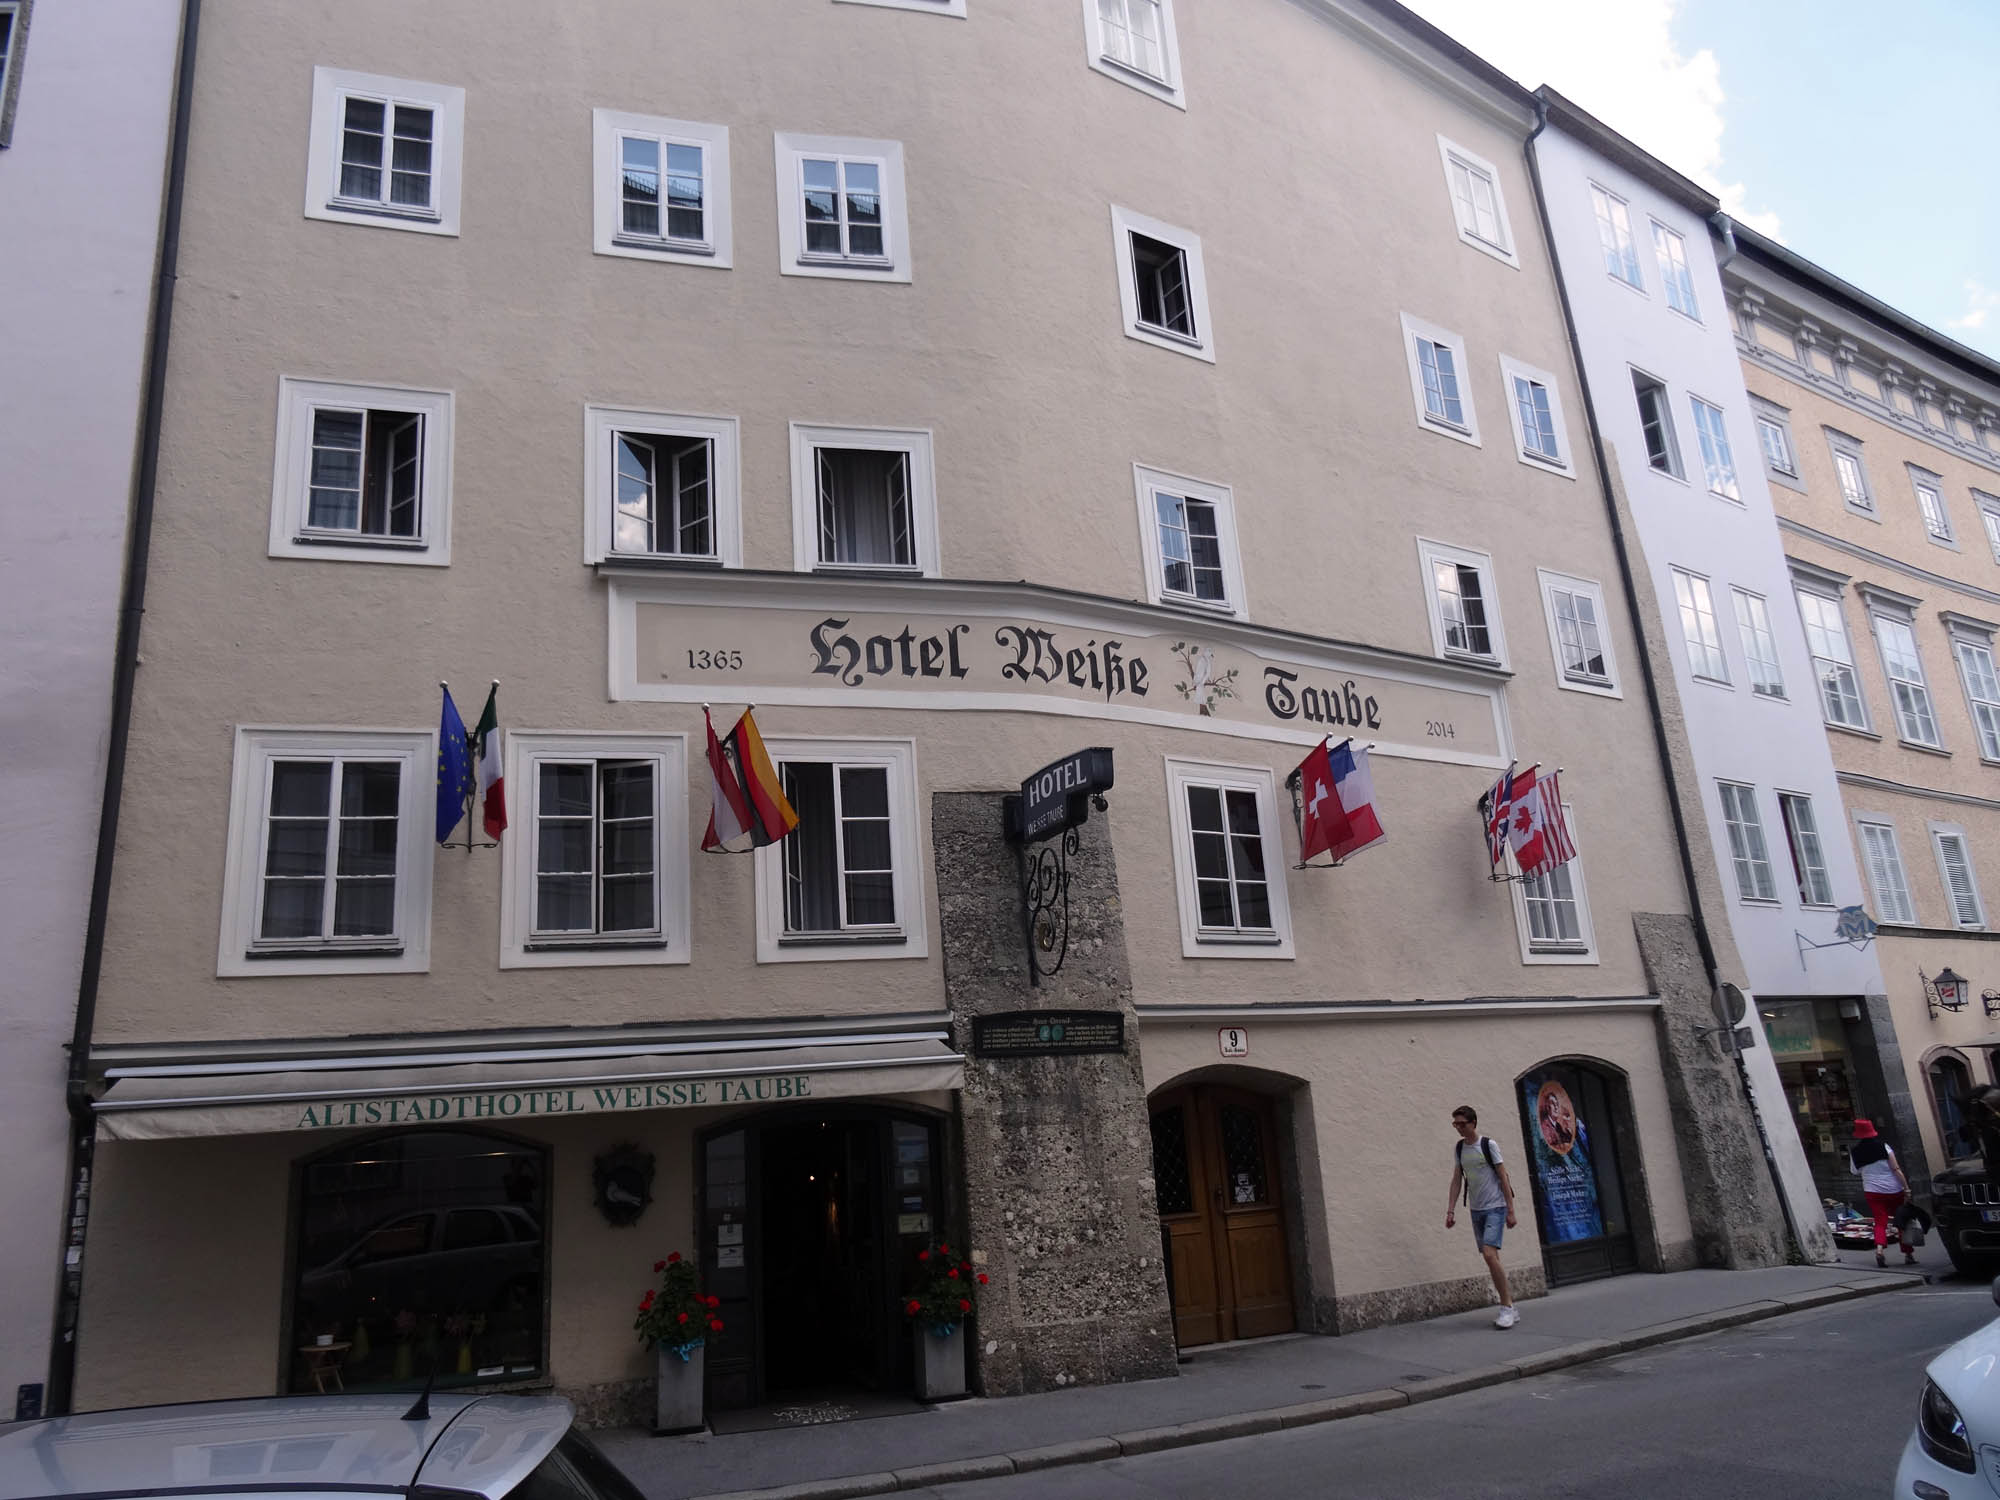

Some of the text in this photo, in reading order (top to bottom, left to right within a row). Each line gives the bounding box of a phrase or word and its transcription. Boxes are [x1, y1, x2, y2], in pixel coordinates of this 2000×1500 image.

[687, 649, 743, 671] 1365
[809, 618, 970, 687] Hotel
[1263, 666, 1381, 731] Taube
[1425, 720, 1455, 740] 2014
[1028, 759, 1087, 806] HOTEL
[1027, 814, 1047, 835] WEISSE
[1229, 1030, 1238, 1048] 9
[297, 1075, 812, 1129] ALTSTADTHOTEL WEISSE TAUBE
